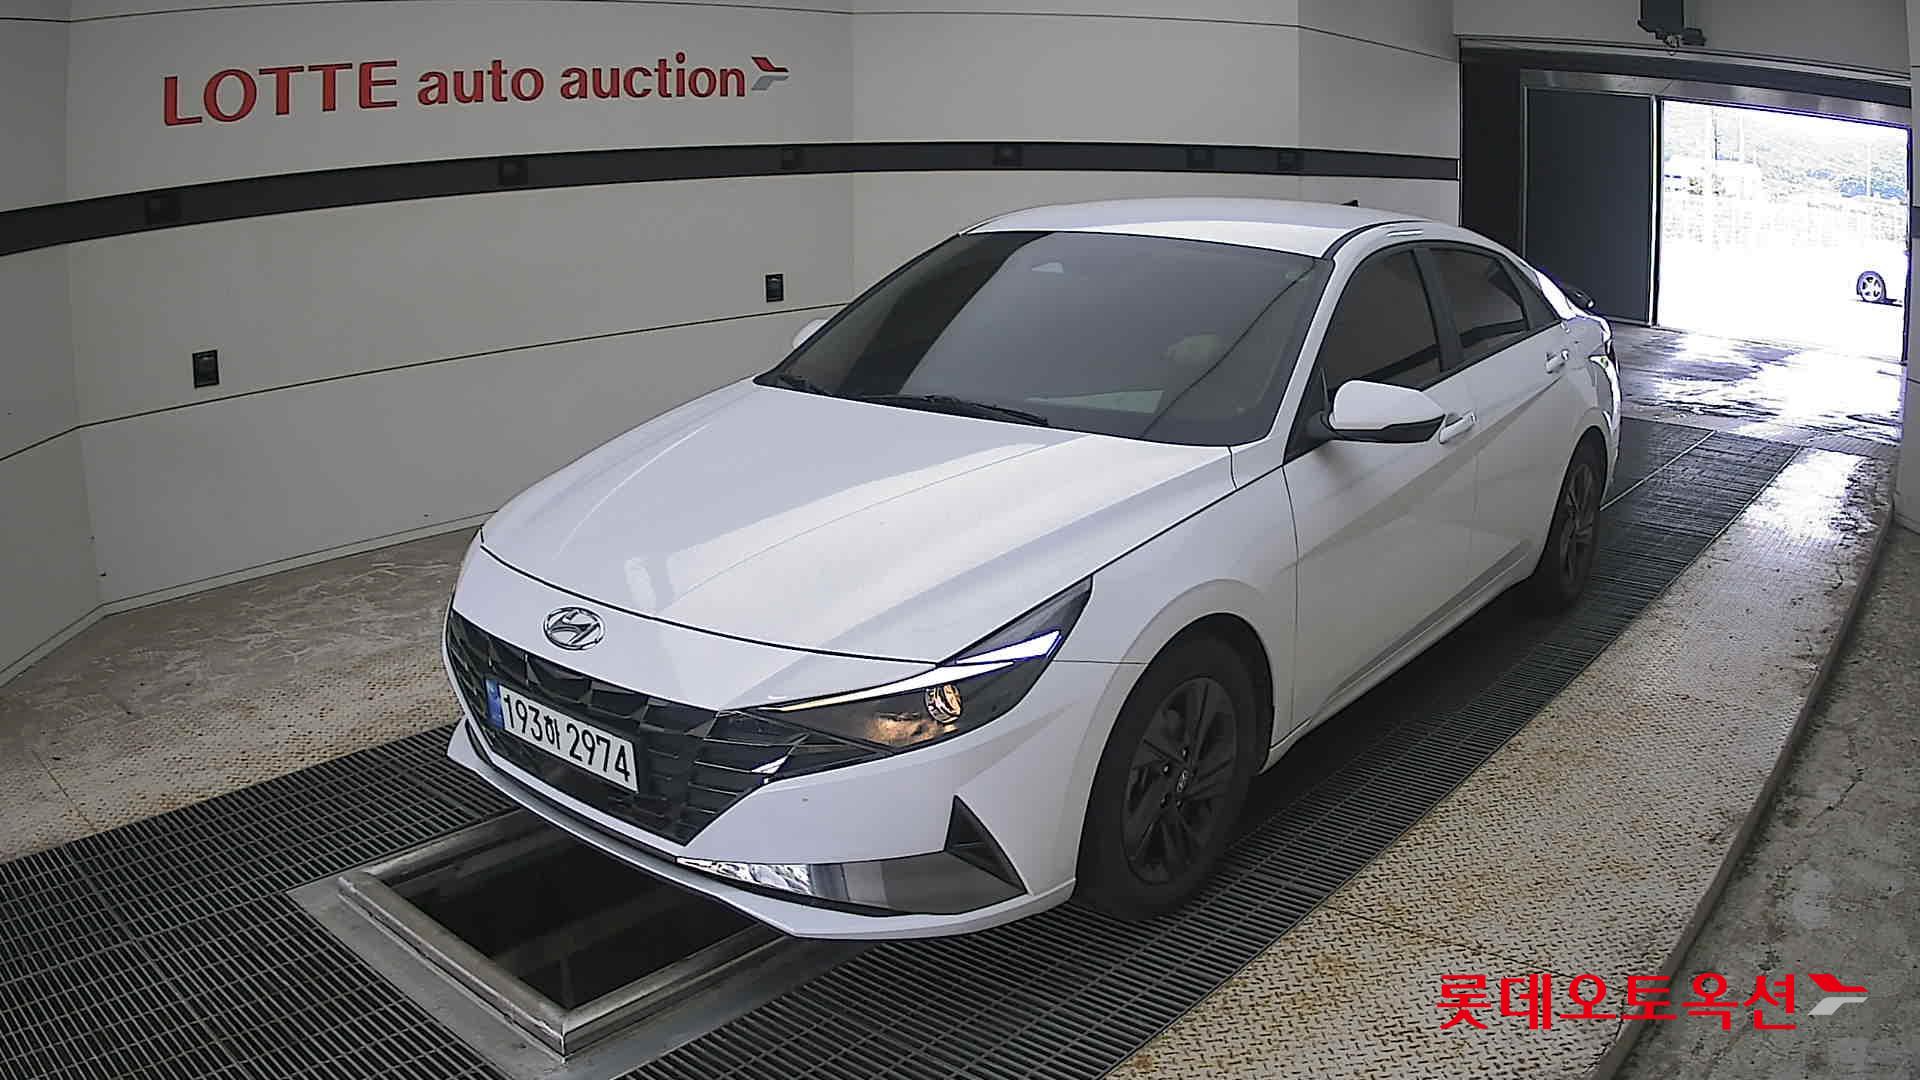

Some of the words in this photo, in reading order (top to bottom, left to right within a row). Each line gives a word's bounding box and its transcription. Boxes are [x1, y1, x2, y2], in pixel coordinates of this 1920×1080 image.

[163, 60, 398, 126] LOTTE
[417, 60, 545, 105] auto
[560, 52, 746, 100] auction
[503, 694, 560, 750] 193하
[566, 723, 631, 782] 2974
